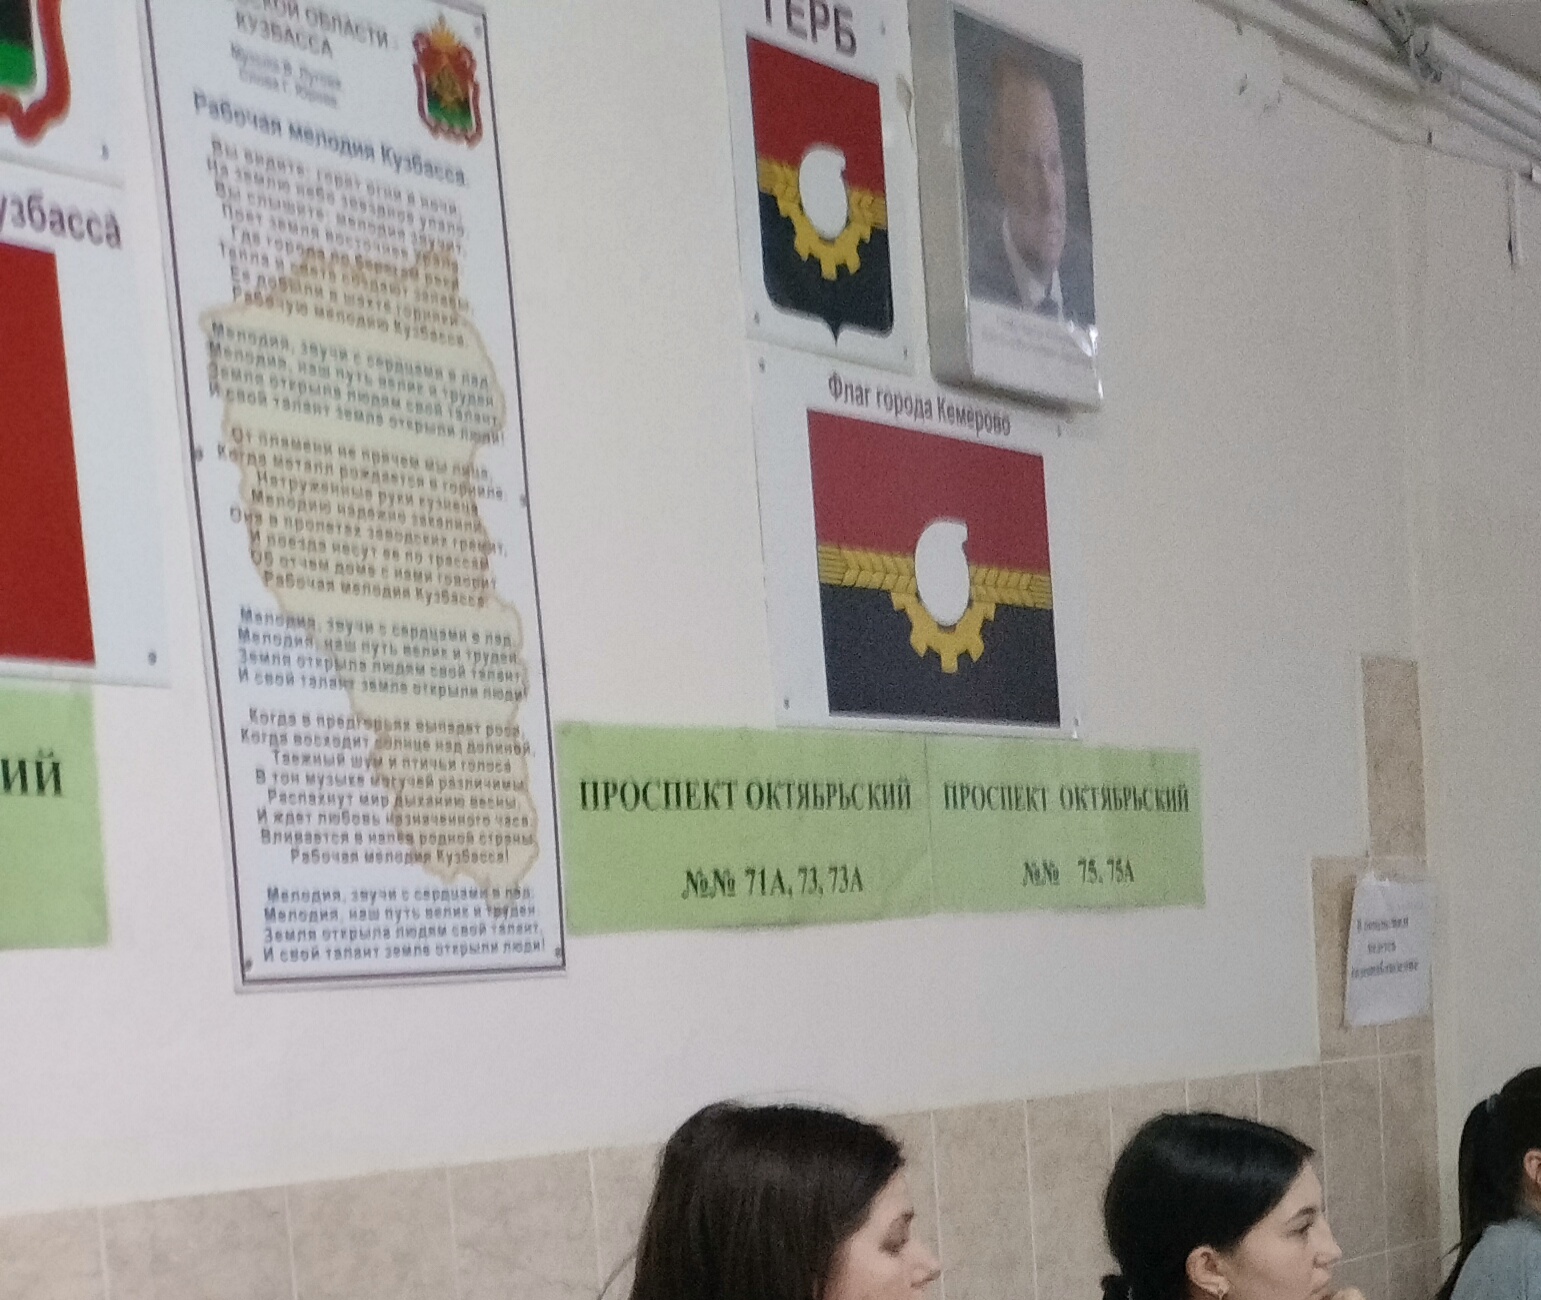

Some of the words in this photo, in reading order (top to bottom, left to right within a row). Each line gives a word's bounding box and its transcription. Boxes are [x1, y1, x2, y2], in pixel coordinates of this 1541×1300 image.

[236, 11, 333, 59] КУЗБАССА
[193, 91, 282, 138] Рабочая
[288, 117, 375, 163] мелодия
[379, 142, 467, 189] Кузбасса
[828, 371, 871, 407] Флаг
[876, 385, 933, 421] города
[937, 395, 1012, 437] Кемерово
[580, 778, 738, 812] ПРОСПЕКТ
[746, 777, 911, 812] ОКТЯБРЬСКИЙ
[944, 782, 1048, 812] ПРОСПЕКТ
[1059, 781, 1190, 813] ОКТЯБРЬСКИЙ
[800, 865, 824, 896] 73,
[828, 863, 864, 894] 73А
[1106, 855, 1135, 884] 75А
